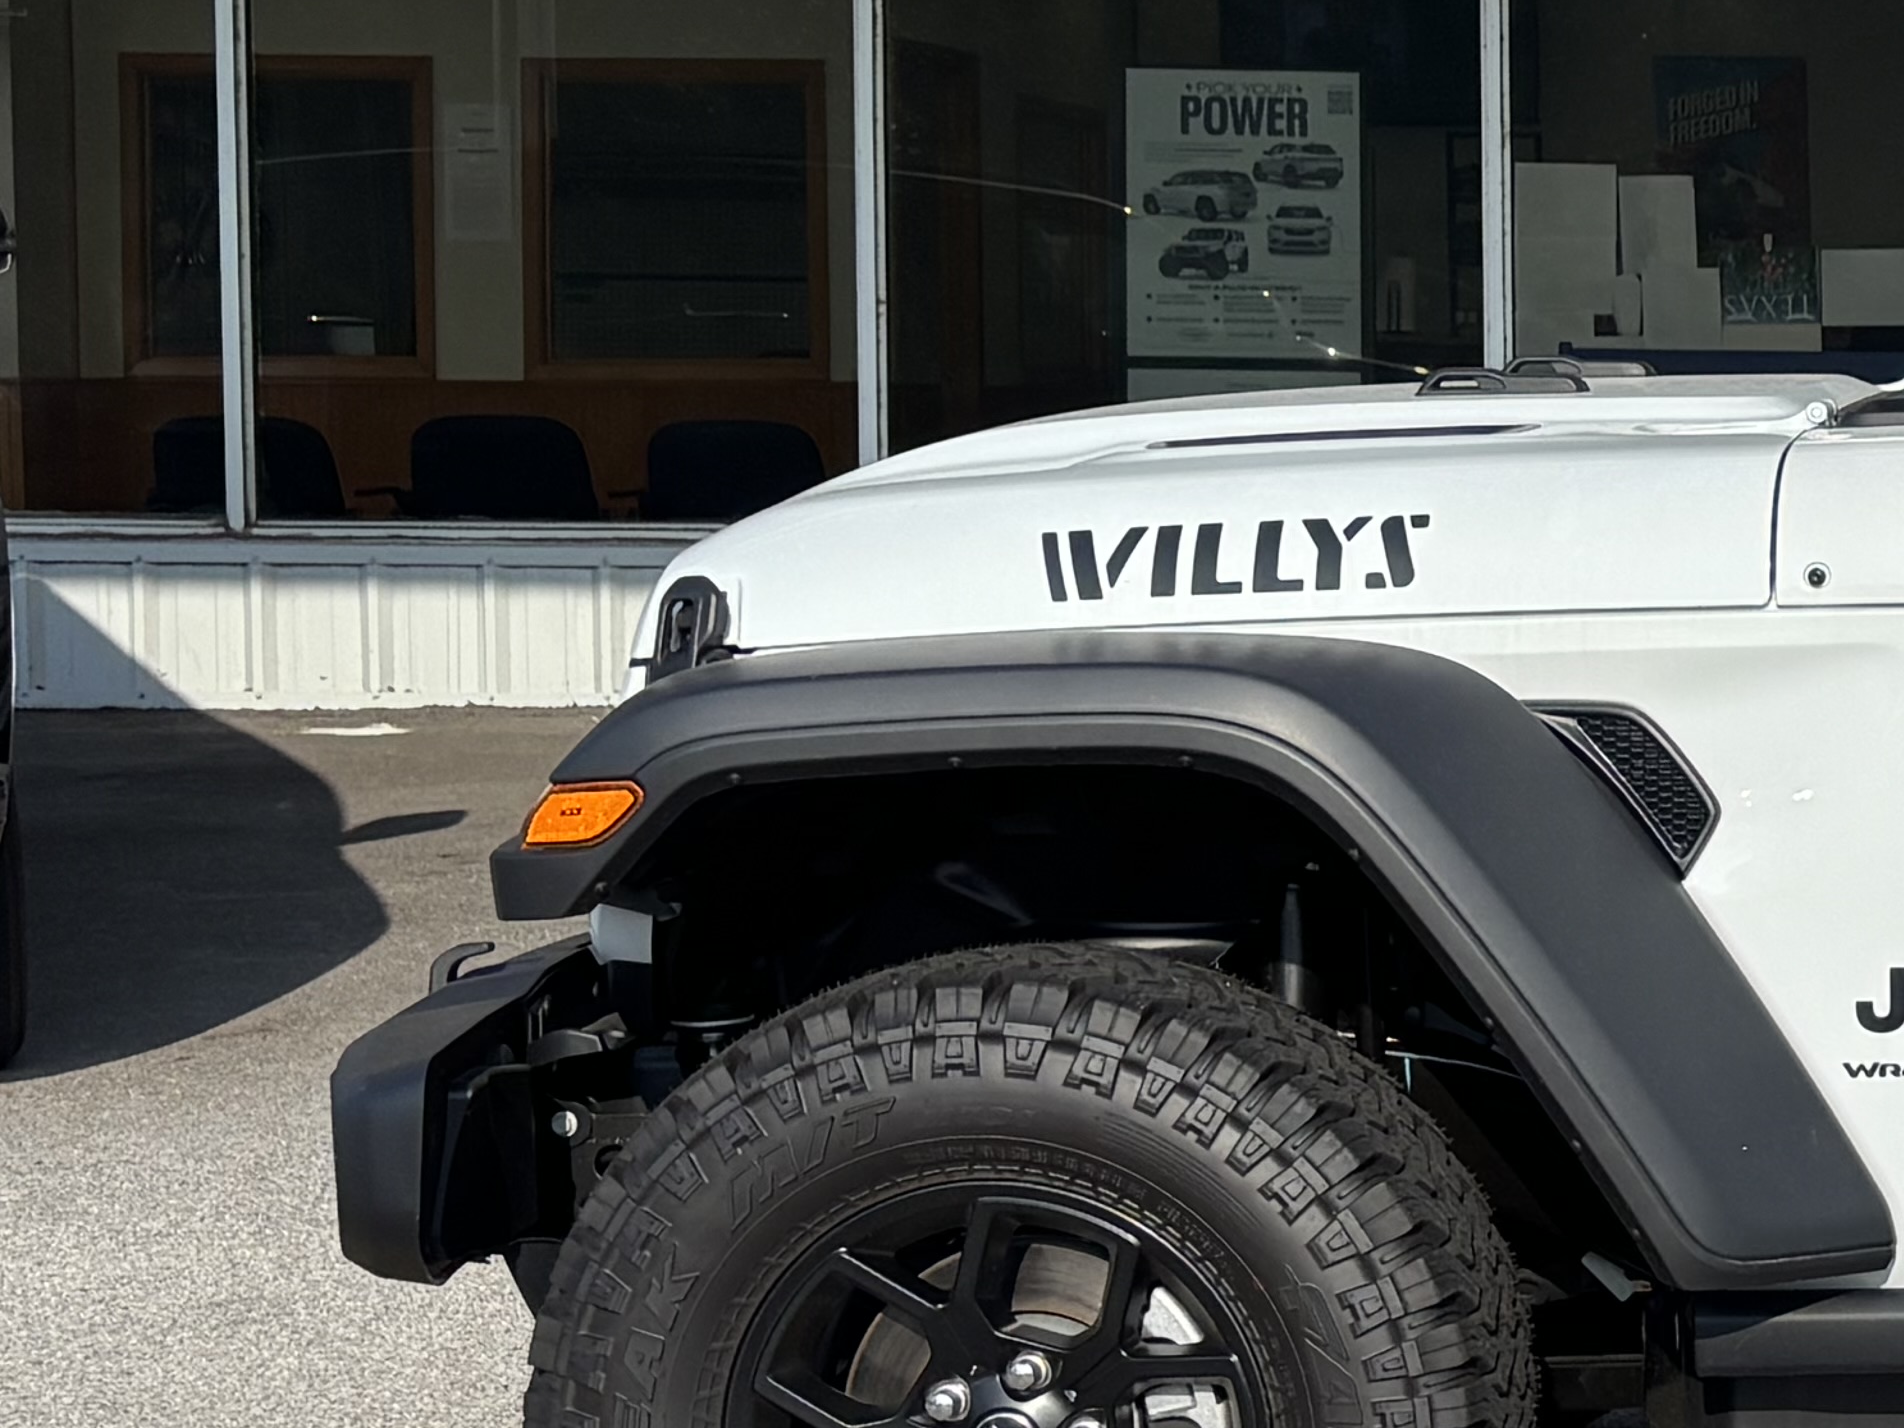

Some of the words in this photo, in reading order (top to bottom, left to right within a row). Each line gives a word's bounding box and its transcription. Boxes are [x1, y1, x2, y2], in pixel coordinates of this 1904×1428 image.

[1196, 81, 1237, 95] PICK
[1241, 82, 1293, 97] YOUR
[1667, 85, 1737, 122] FORGED
[1739, 79, 1759, 106] IN
[1180, 95, 1308, 138] POWER
[1668, 106, 1758, 147] FREEDOM.
[1724, 294, 1815, 321] TEXAS
[1042, 514, 1430, 602] WILLYS
[728, 1096, 896, 1232] M/T
